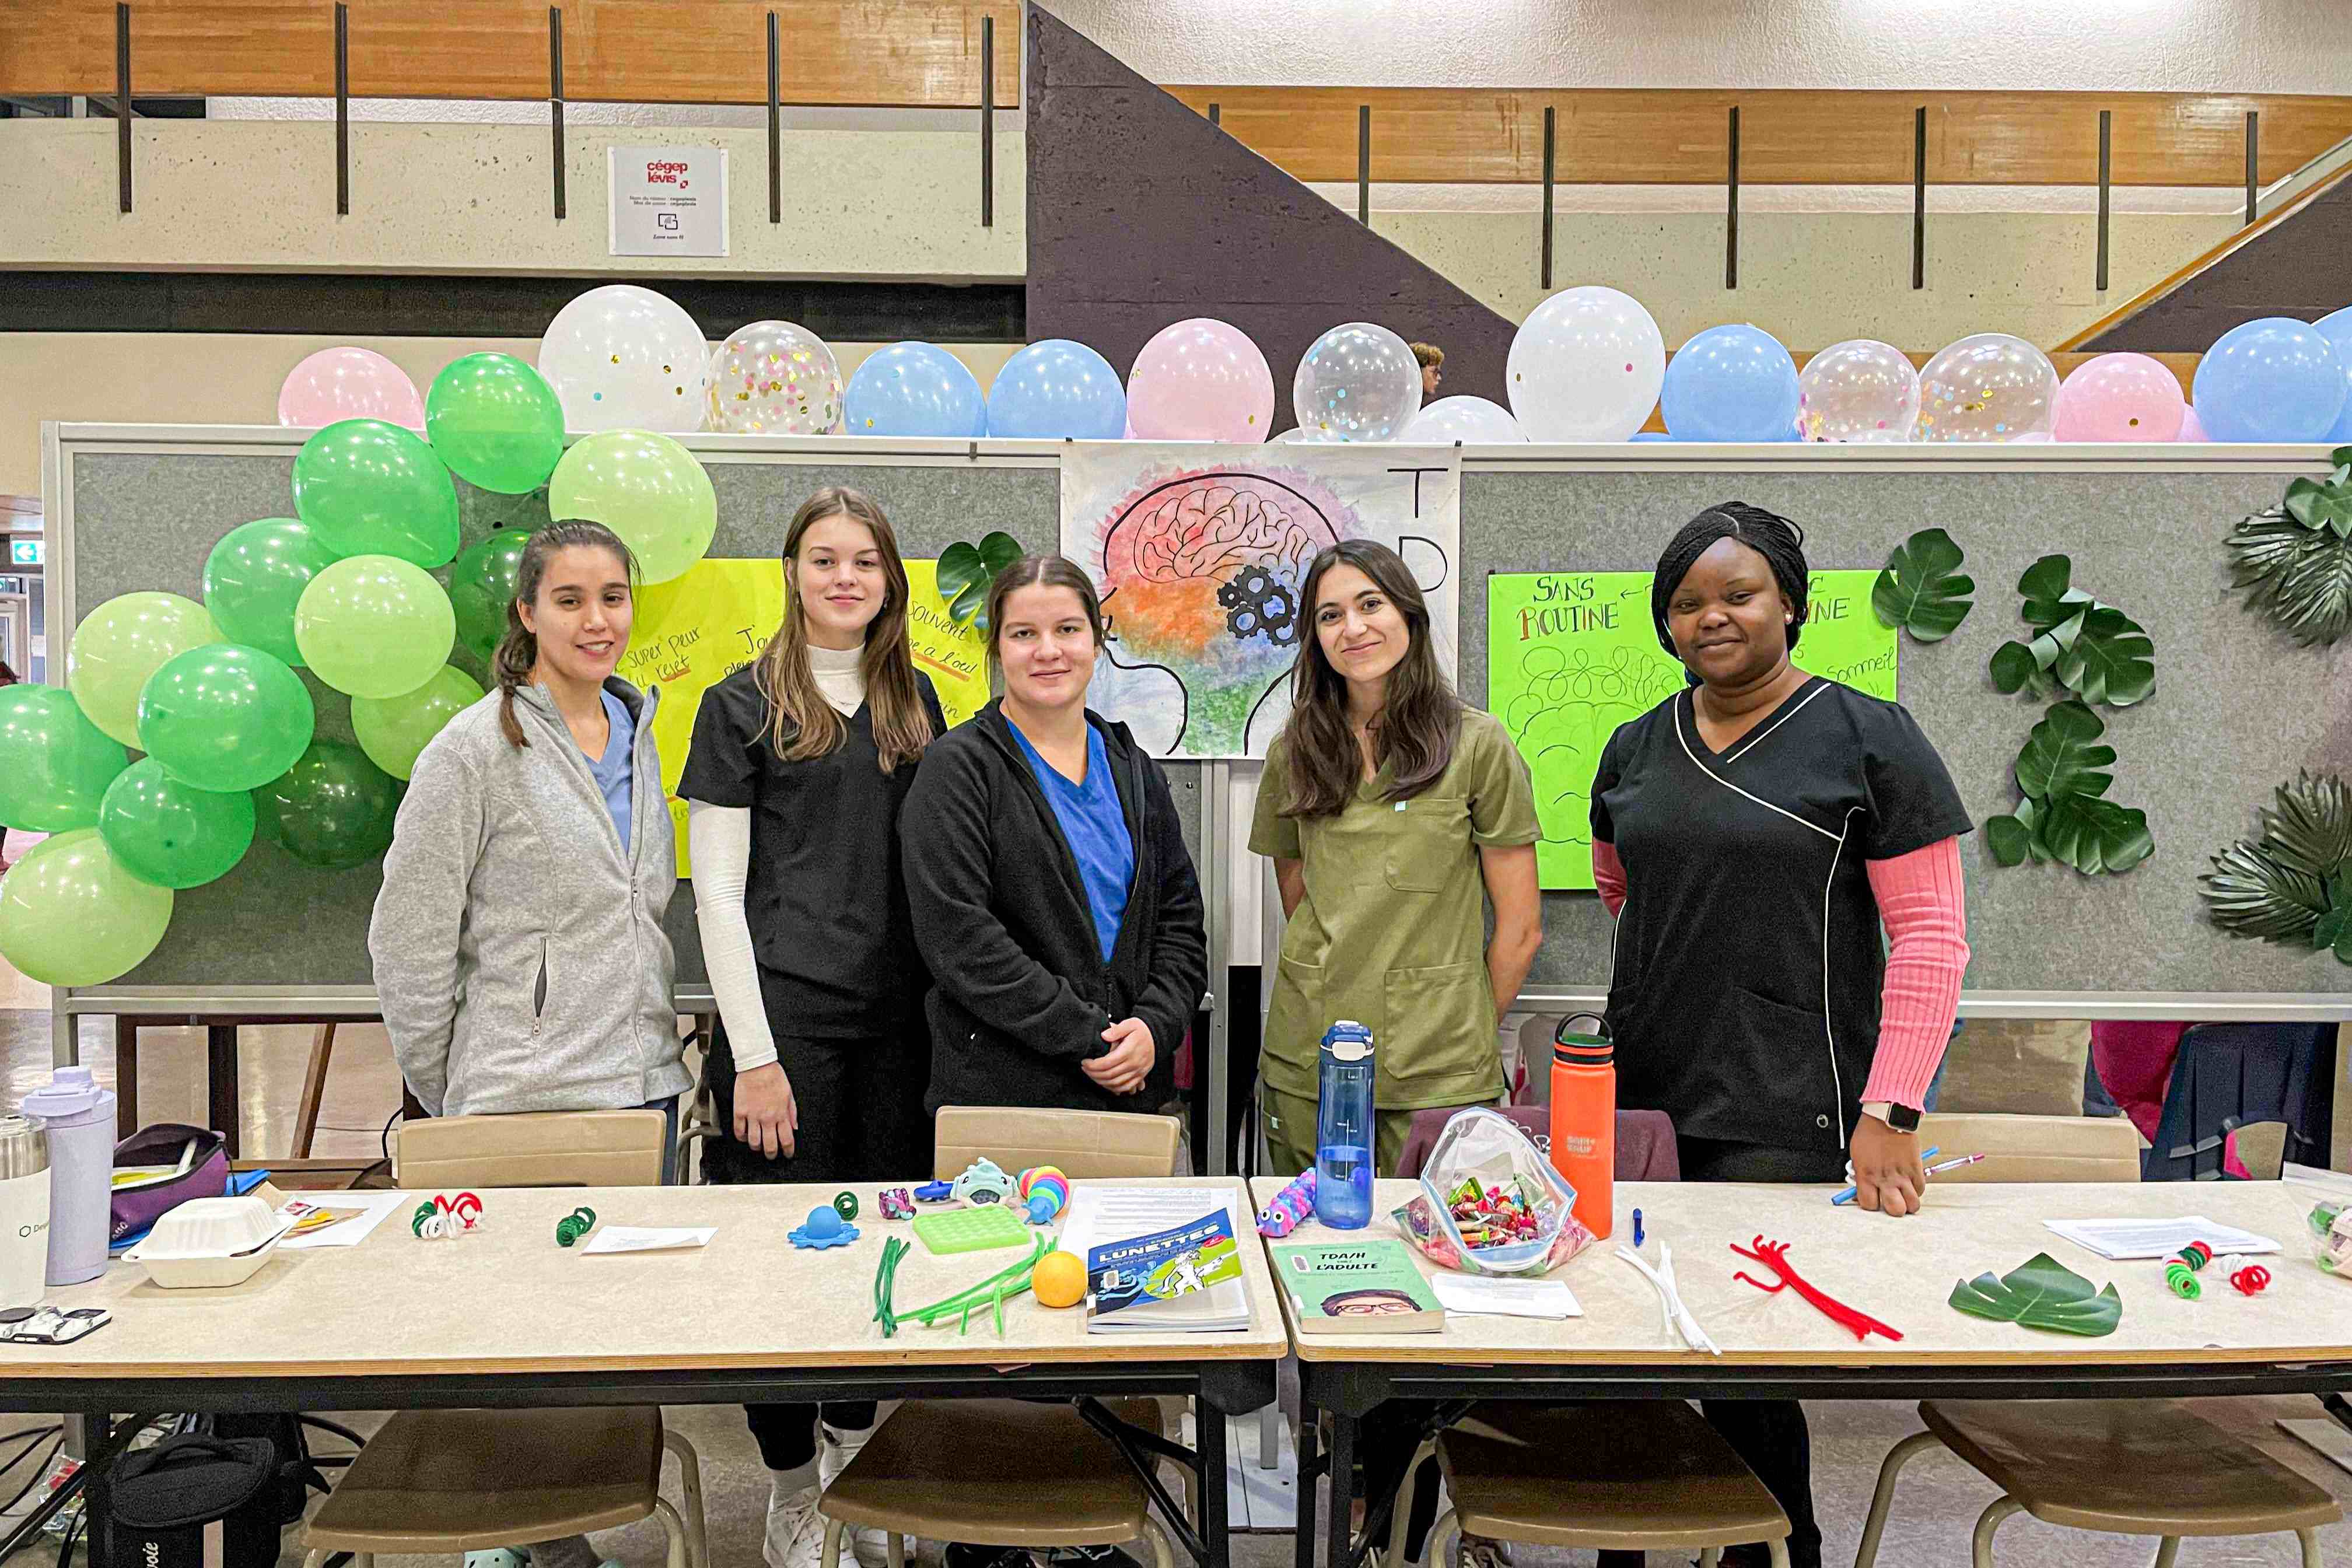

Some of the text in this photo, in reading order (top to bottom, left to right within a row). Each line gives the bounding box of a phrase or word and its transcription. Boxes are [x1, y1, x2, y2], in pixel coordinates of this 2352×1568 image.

[647, 159, 688, 174] cégep
[648, 172, 677, 183] lévis
[1534, 575, 1594, 602] SANS
[1517, 602, 1619, 640] ROUTINE
[1098, 1224, 1220, 1262] LUNETTES
